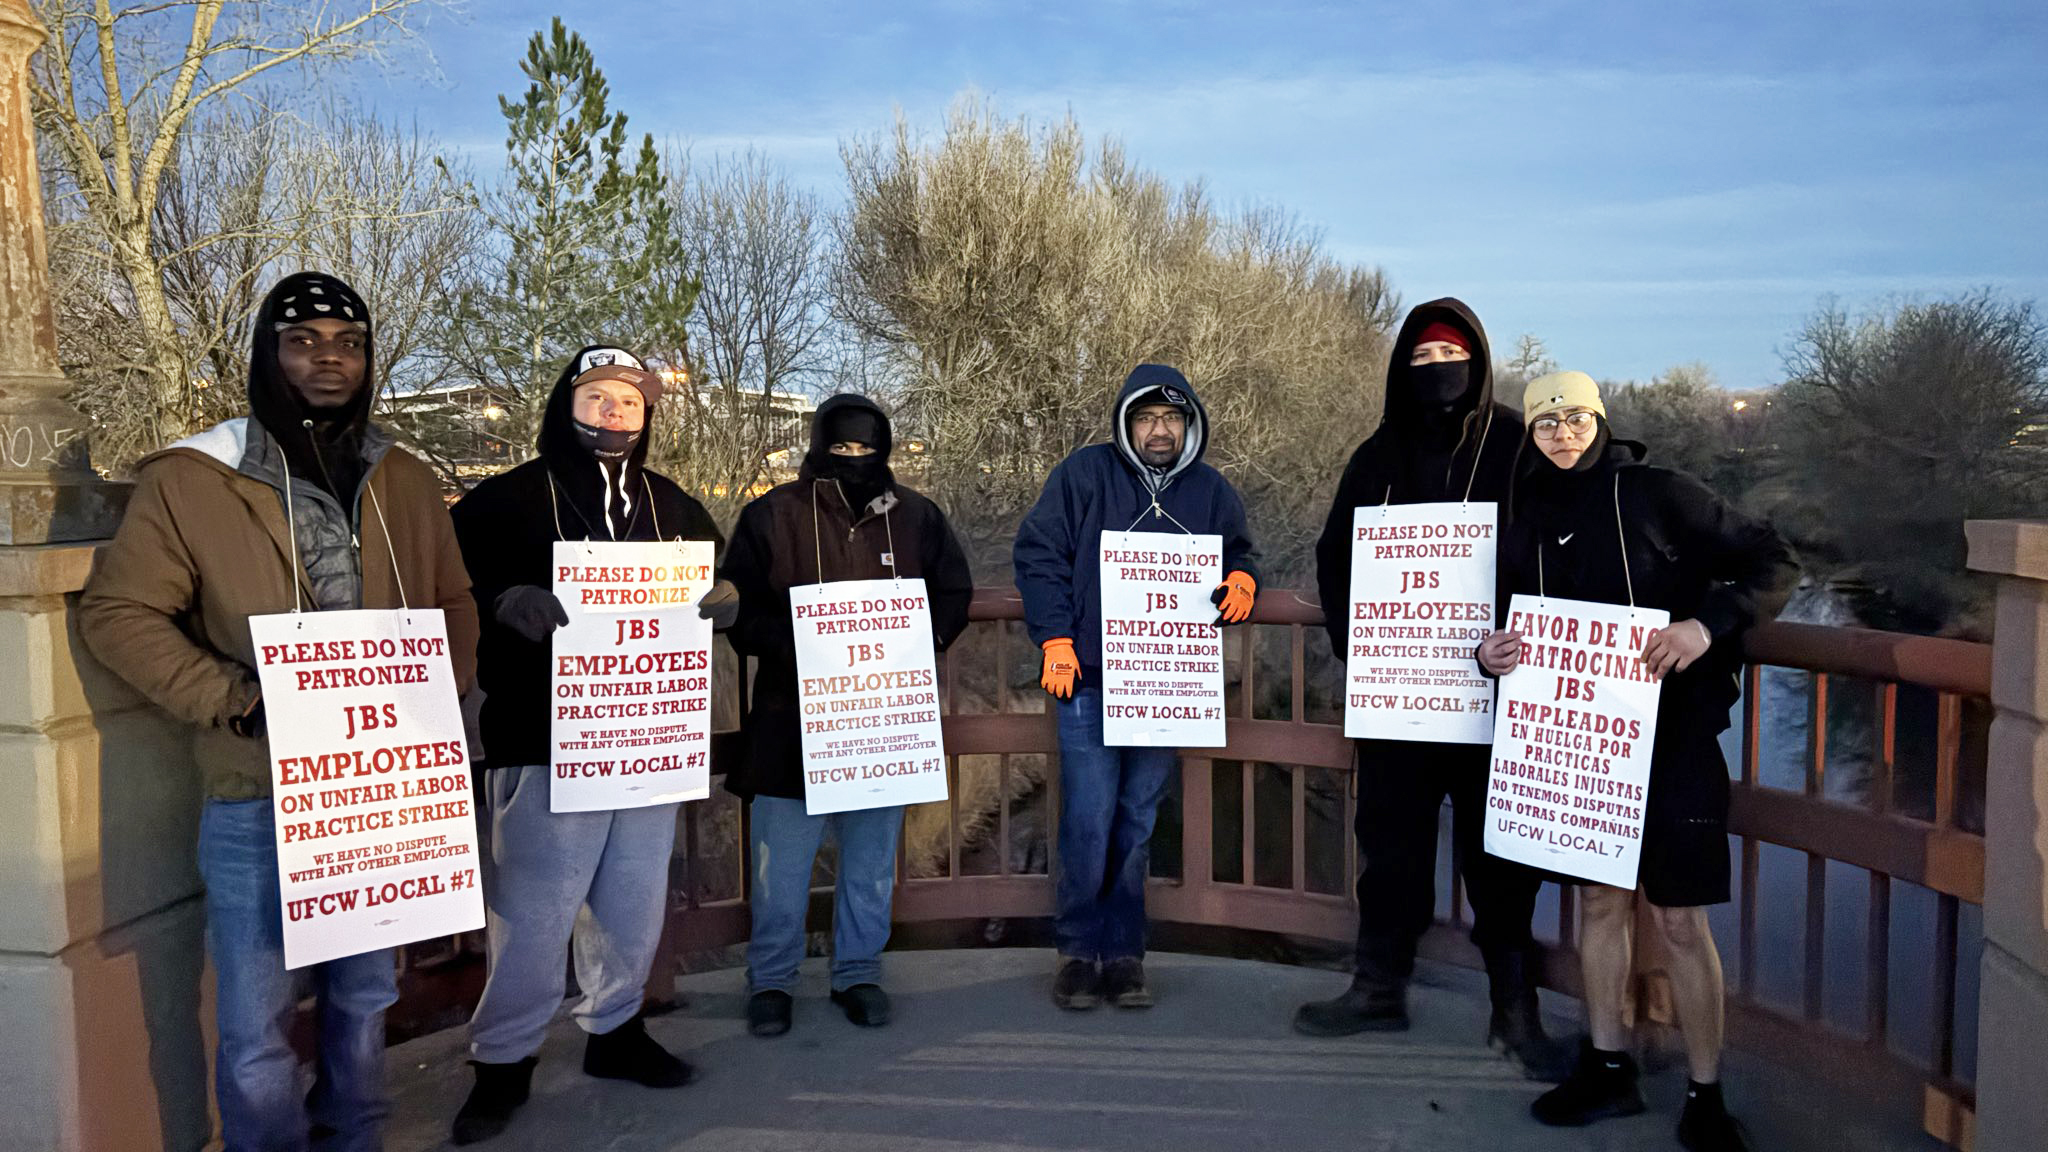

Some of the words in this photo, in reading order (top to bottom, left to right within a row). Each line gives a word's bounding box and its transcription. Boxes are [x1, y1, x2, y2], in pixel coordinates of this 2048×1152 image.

[1357, 526, 1417, 540] PLEASE
[1422, 524, 1448, 538] DO
[1453, 524, 1493, 538] NOT
[1104, 550, 1158, 564] PLEASE
[1161, 552, 1182, 565] DO
[1186, 554, 1218, 566] NOT
[1375, 544, 1472, 559] PATRONIZE
[558, 566, 634, 582] PLEASE
[639, 567, 667, 582] DO
[672, 566, 709, 580] NOT
[1120, 568, 1201, 583] PATRONIZE
[1400, 571, 1439, 594] JBS
[581, 587, 689, 604] PATRONIZE
[1146, 593, 1178, 613] JBS
[796, 601, 858, 618] PLEASE
[861, 600, 886, 613] DO
[890, 597, 924, 611] NOT
[1354, 602, 1491, 621] EMPLOYEES
[615, 618, 660, 646] JBS
[816, 616, 910, 634] PATRONIZE
[1106, 620, 1218, 639] EMPLOYEES
[1353, 626, 1374, 638] ON
[1378, 626, 1433, 638] UNFAIR
[1437, 627, 1490, 642] LABOR
[1511, 611, 1579, 642] FAVOR
[1588, 620, 1618, 648] DE
[262, 641, 356, 665] PLEASE
[362, 639, 396, 658] DO
[402, 638, 444, 657] NOT
[847, 643, 884, 667] JBS
[1106, 642, 1125, 653] ON
[1128, 642, 1174, 654] UNFAIR
[1177, 644, 1219, 656] LABOR
[1353, 645, 1428, 658] PRACTICE
[1432, 646, 1476, 660] STRI
[558, 650, 707, 676] EMPLOYEES
[1107, 659, 1170, 672] PRACTICE
[1174, 661, 1219, 673] STRIKE
[1429, 669, 1469, 678] DISPUTE
[296, 664, 429, 690] PATRONIZE
[557, 684, 584, 698] ON
[589, 682, 653, 697] UNFAIR
[657, 677, 708, 694] LABOR
[803, 669, 932, 696] EMPLOYEES
[1399, 677, 1431, 685] OTHER
[1434, 678, 1488, 688] EMPLOYER
[1554, 676, 1595, 702] JBS
[557, 703, 648, 720] PRACTICE
[652, 698, 706, 715] STRIKE
[804, 702, 826, 715] ON
[830, 697, 883, 712] UNFAIR
[887, 693, 935, 707] LABOR
[1107, 705, 1148, 718] UFCW
[1152, 706, 1201, 719] LOCAL
[1204, 707, 1220, 719] #7
[1350, 694, 1398, 709] UFCW
[1403, 696, 1464, 712] LOCAL
[1469, 698, 1490, 714] #7
[344, 703, 397, 740] JBS
[806, 716, 880, 734] PRACTICE
[884, 710, 936, 726] STRIKE
[1507, 700, 1640, 740] EMPLEADOS
[559, 739, 588, 750] WITH
[591, 737, 614, 749] ANY
[616, 735, 652, 748] OTHER
[652, 732, 704, 745] EMPLOYER
[580, 731, 597, 739] WE
[600, 730, 627, 738] HAVE
[630, 728, 645, 737] NO
[648, 724, 687, 736] DISPUTE
[842, 739, 865, 748] HAVE
[883, 734, 919, 744] DISPUTE
[1511, 722, 1528, 740] EN
[1534, 727, 1592, 752] HUELGA
[1599, 738, 1631, 758] POR
[809, 751, 833, 759] WITH
[836, 749, 853, 757] ANY
[856, 746, 886, 755] OTHER
[888, 741, 936, 752] EMPLOYER
[1525, 744, 1610, 775] PRACTICAS
[278, 740, 464, 786] EMPLOYEES
[556, 761, 616, 779] UFCW
[620, 755, 682, 775] LOCAL
[687, 752, 706, 768] #7
[808, 767, 857, 784] UFCW
[862, 761, 918, 779] LOCAL
[922, 758, 940, 772] #7
[1494, 758, 1568, 787] LABORALES
[1574, 774, 1642, 801] INJUSTAS
[281, 793, 314, 814] ON
[320, 783, 398, 808] UNFAIR
[402, 774, 468, 798] LABOR
[1492, 778, 1508, 792] NO
[1512, 783, 1569, 806] TENEMOS
[1574, 796, 1640, 820] DISPUTAS
[283, 810, 393, 843] PRACTICE
[398, 800, 468, 826] STRIKE
[1490, 796, 1512, 812] CON
[1516, 802, 1556, 822] OTRAS
[1561, 812, 1640, 840] COMPAÑIAS
[1498, 818, 1544, 840] UFCW
[1549, 831, 1608, 856] LOCAL
[1616, 845, 1624, 858] 7
[313, 853, 334, 865] WE
[337, 847, 371, 862] HAVE
[374, 844, 392, 856] NO
[396, 835, 447, 852] DISPUTE
[288, 868, 325, 883] WITH
[328, 862, 354, 877] ANY
[358, 855, 401, 871] OTHER
[404, 844, 470, 864] EMPLOYER
[287, 889, 358, 922] UFCW
[365, 875, 445, 907] LOCAL
[450, 869, 474, 892] #7
